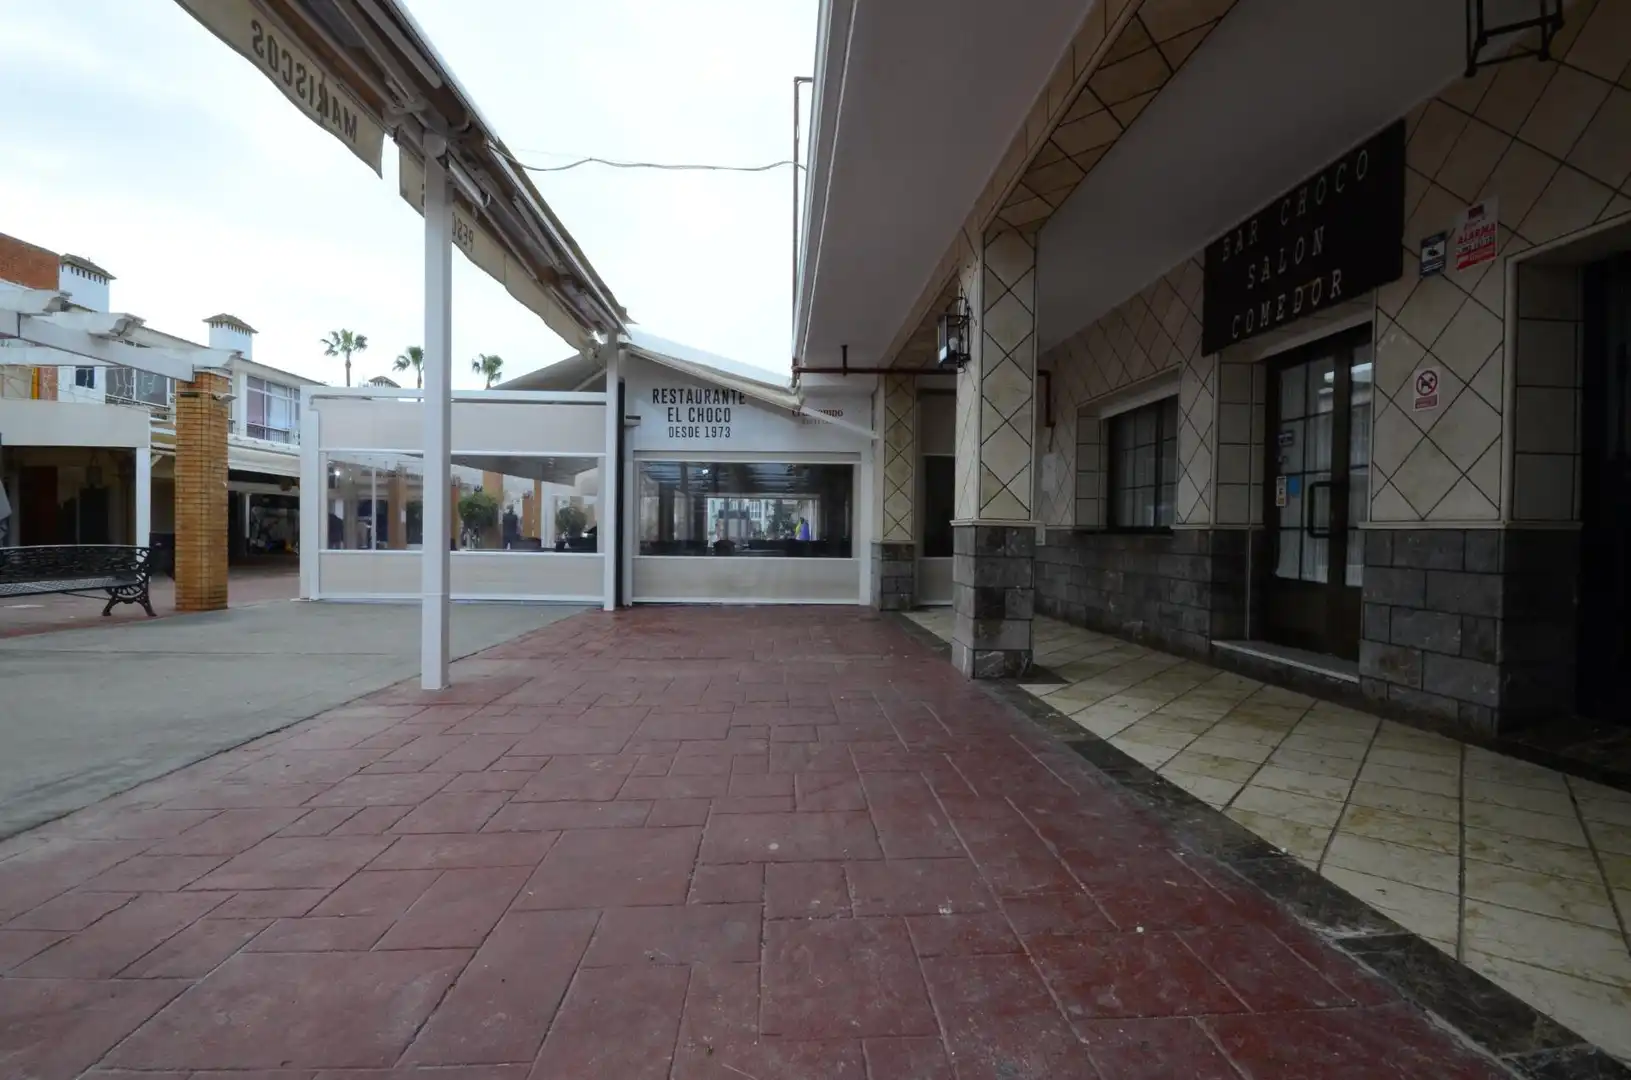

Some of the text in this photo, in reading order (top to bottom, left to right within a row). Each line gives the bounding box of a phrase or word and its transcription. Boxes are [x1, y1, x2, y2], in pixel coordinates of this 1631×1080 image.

[1222, 150, 1369, 262] BAR CHOCO
[1247, 226, 1325, 289] SALON
[1231, 269, 1342, 339] COMEDOR
[652, 388, 746, 405] RESTAURANTE
[667, 407, 731, 423] EL CHOCO
[668, 426, 731, 438] DESDE 1973
